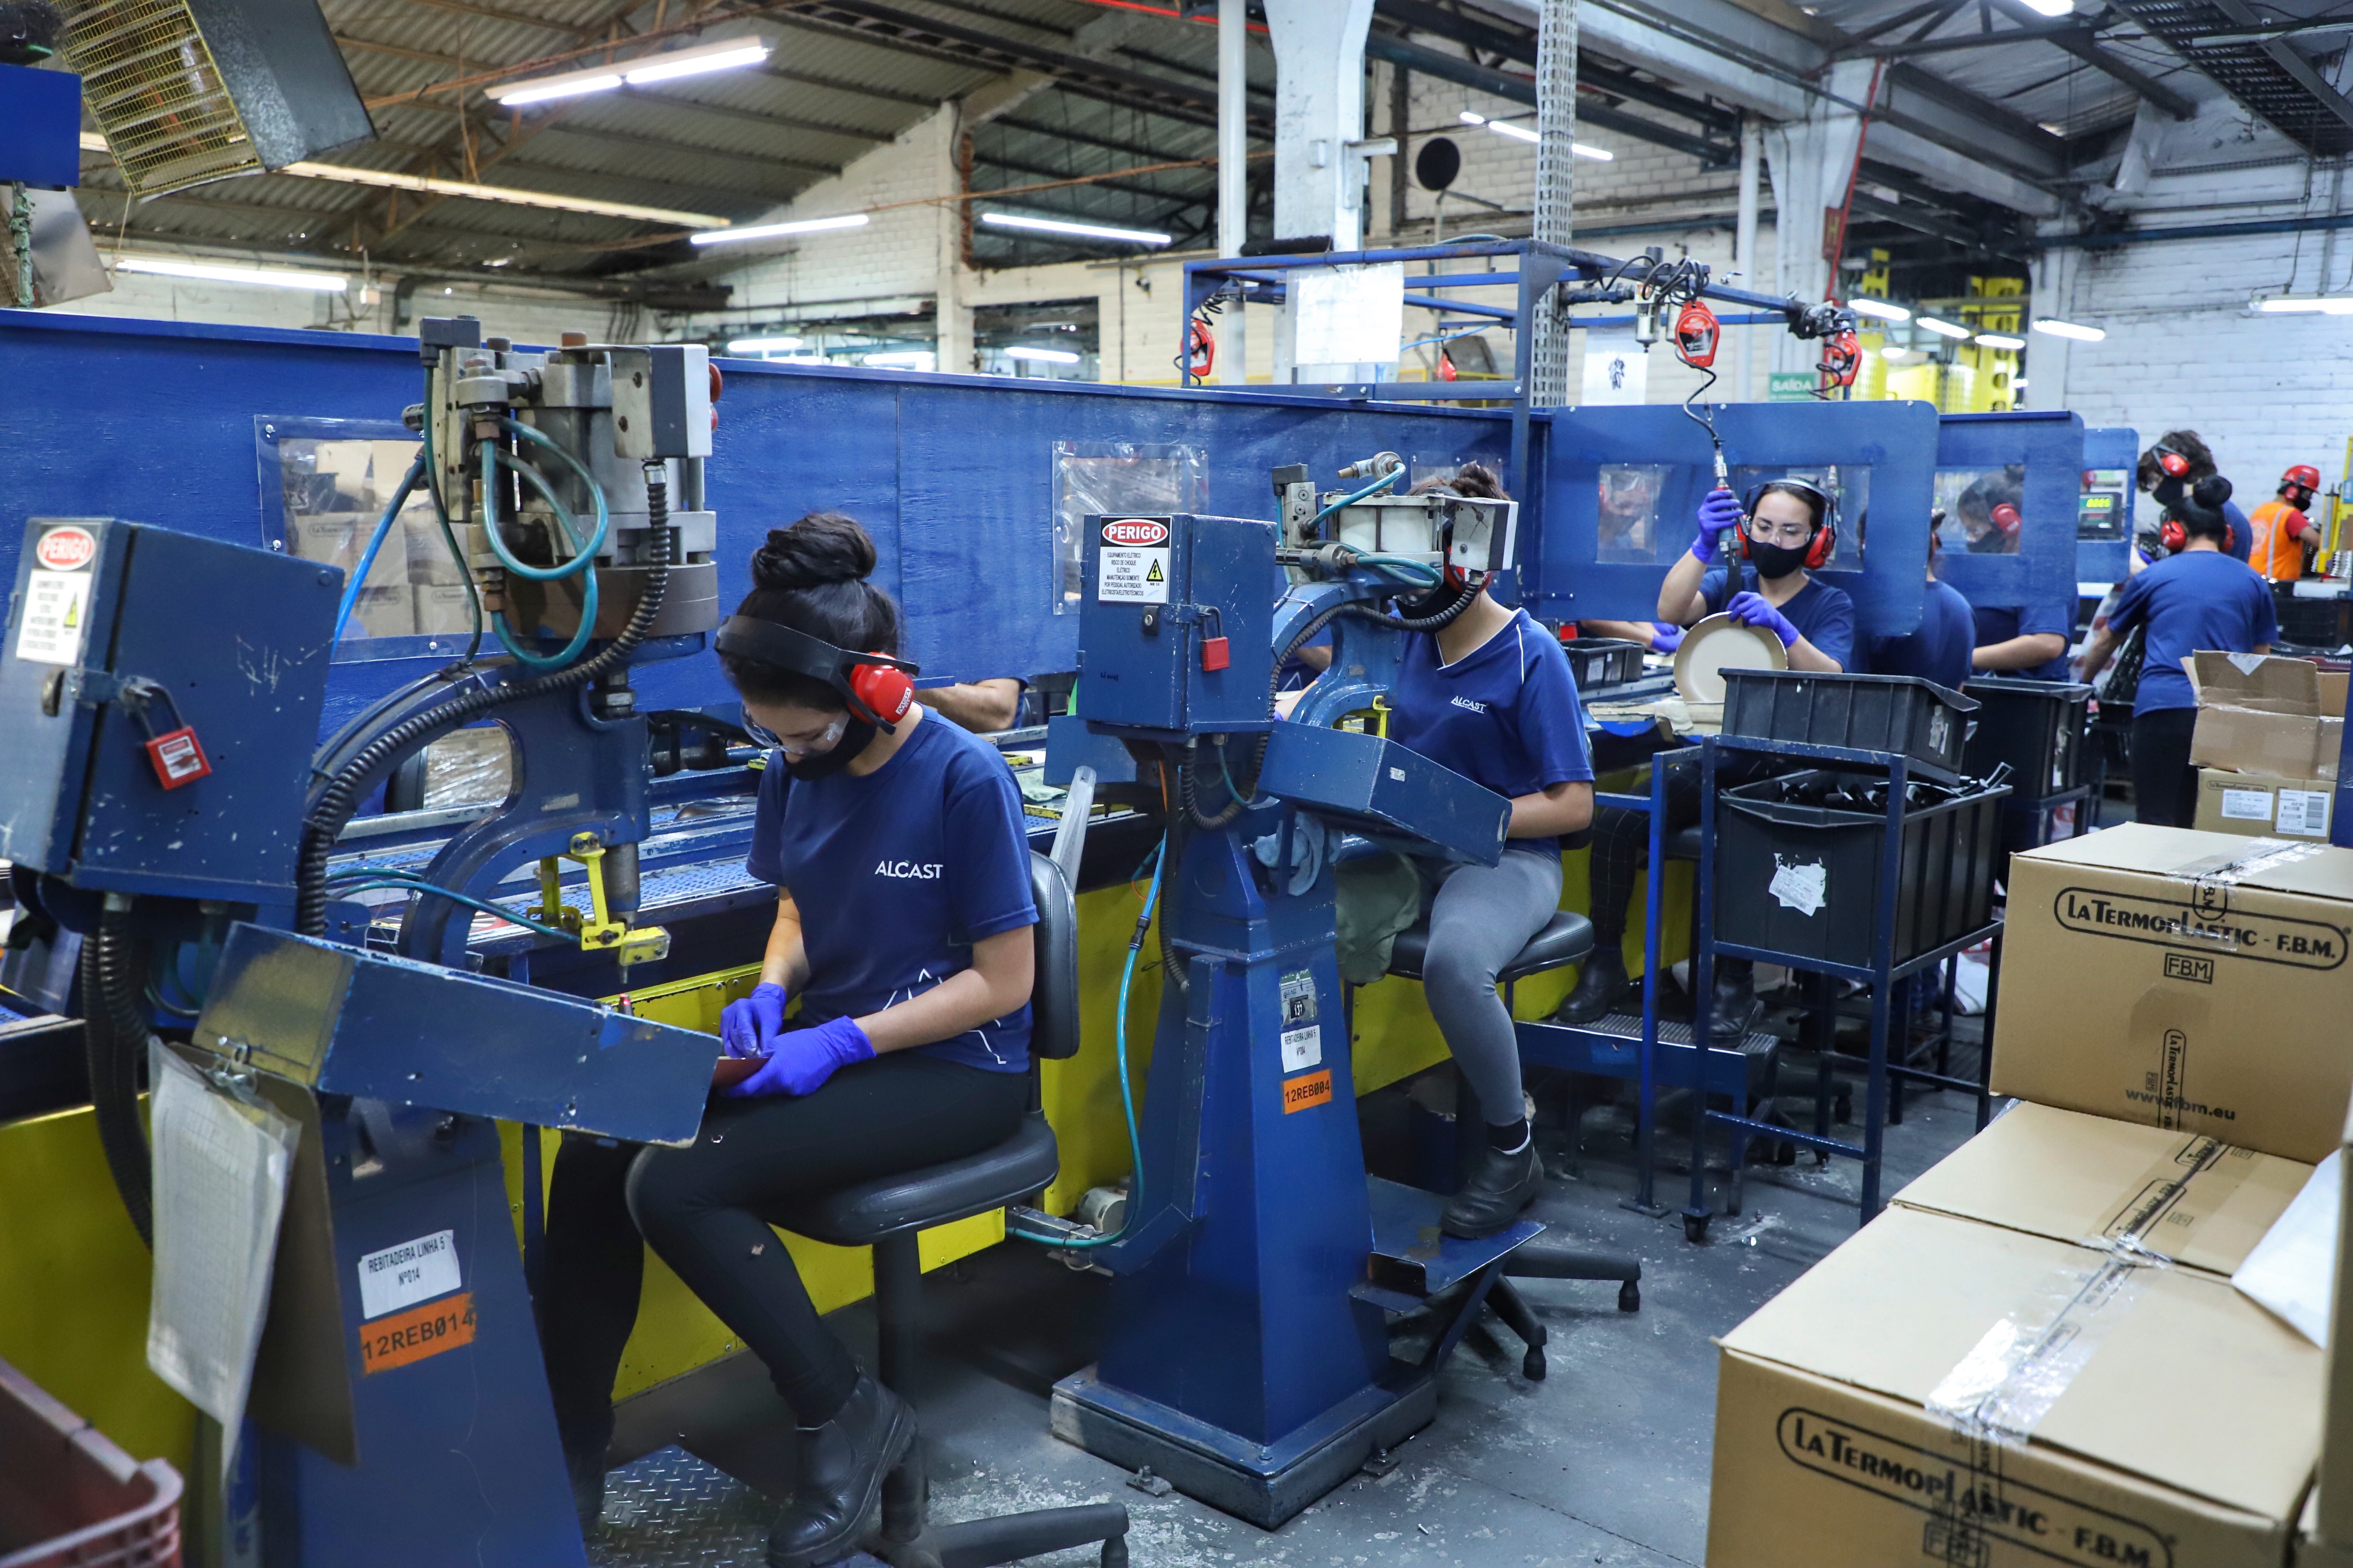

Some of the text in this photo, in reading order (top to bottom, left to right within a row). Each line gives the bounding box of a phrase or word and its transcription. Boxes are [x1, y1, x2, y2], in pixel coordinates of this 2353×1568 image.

[1108, 526, 1161, 540] PERIGO
[42, 537, 89, 559] PERIGO
[898, 691, 910, 713] MSA
[1450, 695, 1487, 713] ALCAST
[874, 860, 944, 879] ALCAST
[2277, 935, 2336, 958] F.B.M.
[2168, 959, 2210, 979] F.B.M.
[1294, 1003, 1303, 1016] 137
[1285, 1029, 1316, 1045] REBITADEIRA LINHA 5
[368, 1236, 445, 1273] REBITADEIRA LINHA 5
